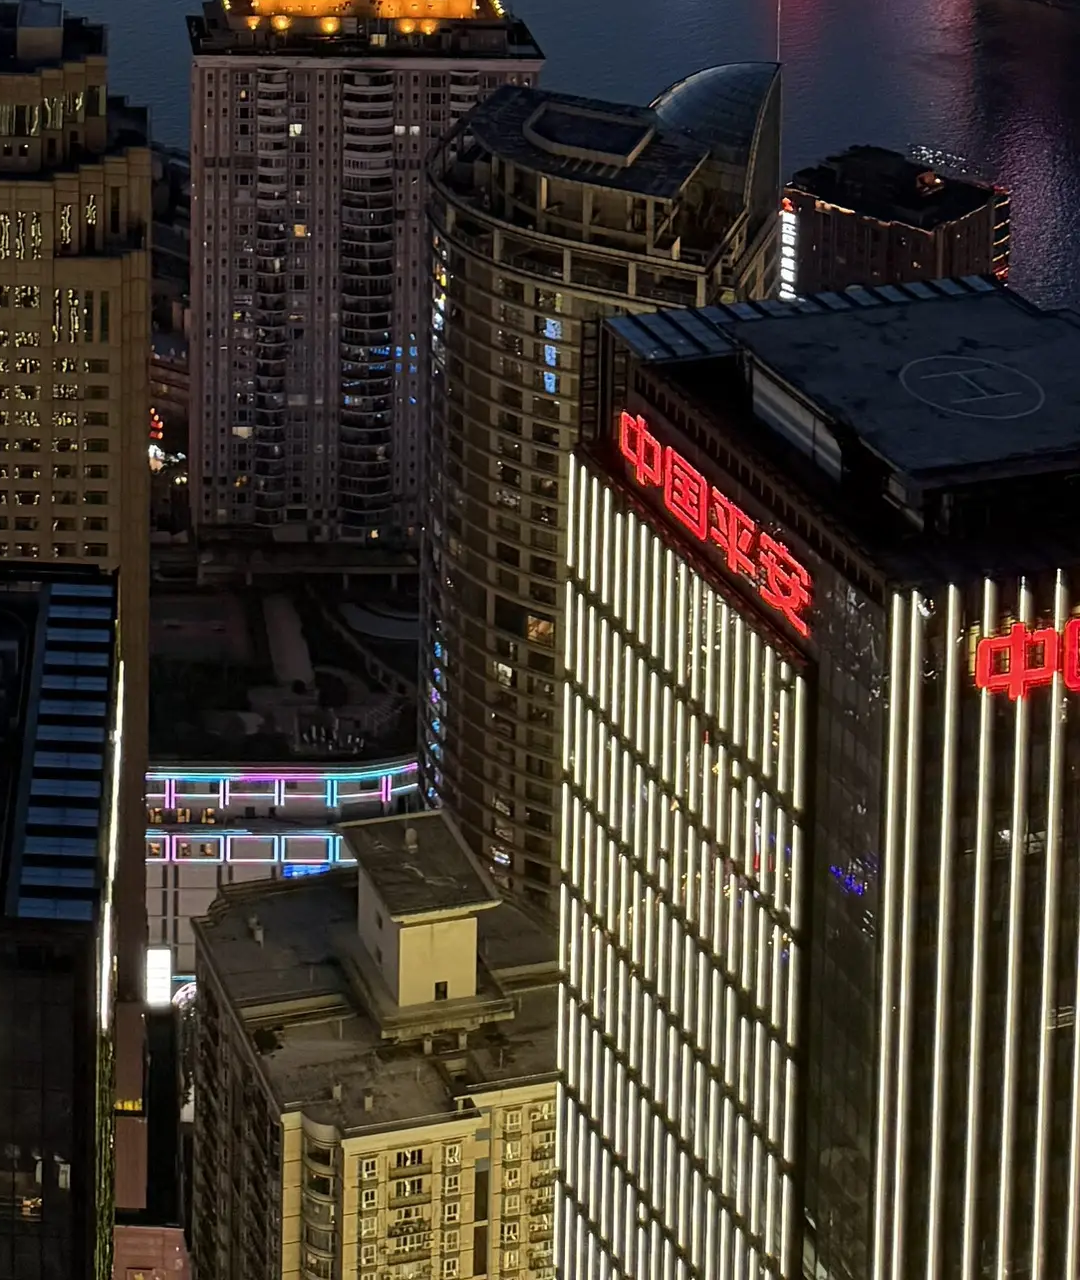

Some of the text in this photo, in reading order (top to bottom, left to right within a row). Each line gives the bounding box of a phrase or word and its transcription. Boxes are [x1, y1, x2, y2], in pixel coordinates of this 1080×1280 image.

[620, 409, 812, 638] 中国平安
[976, 618, 1080, 701] 中
